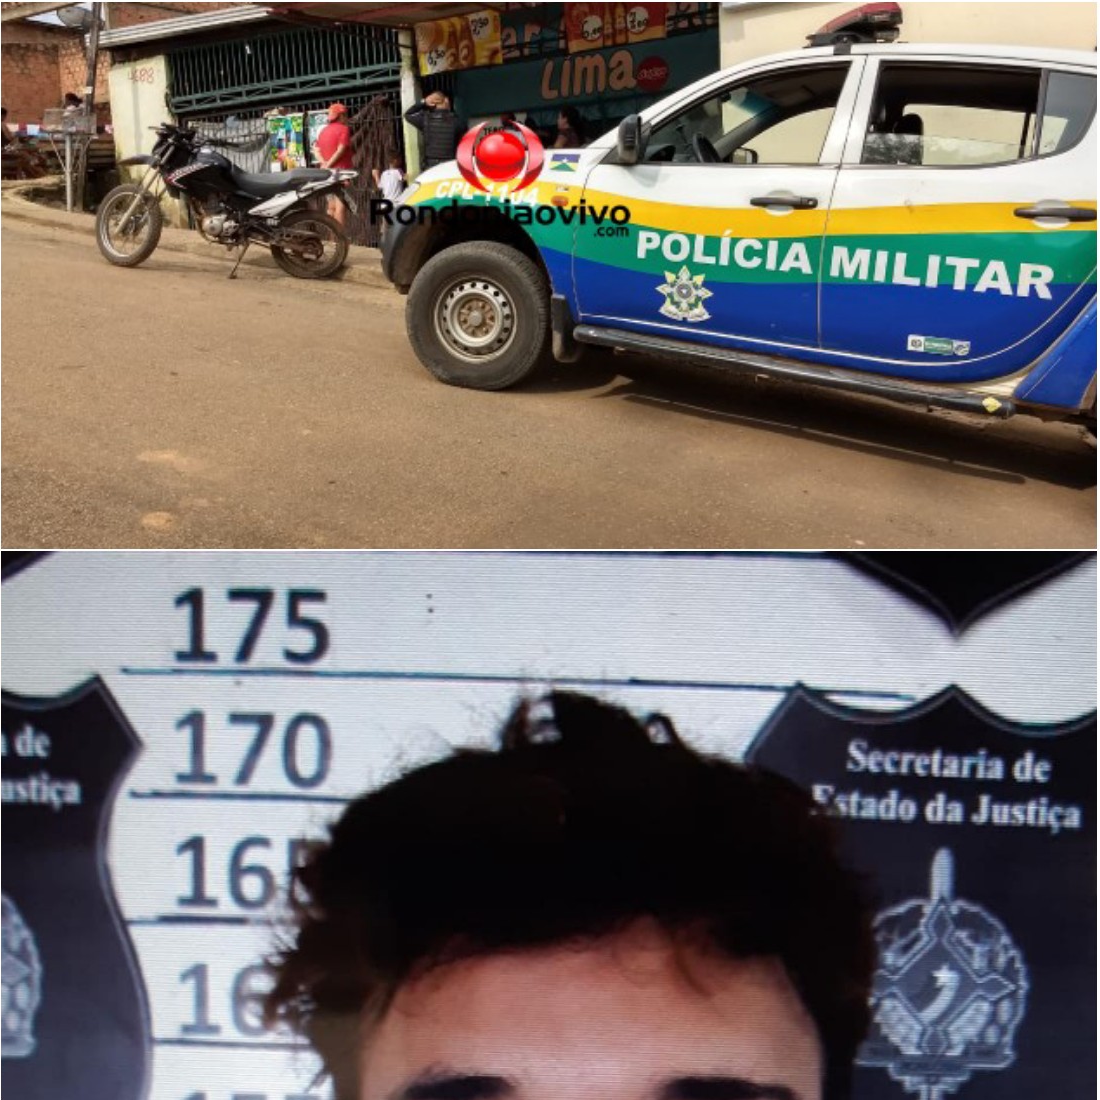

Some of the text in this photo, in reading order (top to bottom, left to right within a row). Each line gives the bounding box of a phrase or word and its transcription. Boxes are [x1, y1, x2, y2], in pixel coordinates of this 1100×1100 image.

[541, 49, 637, 99] Lima
[637, 229, 1054, 300] POLÍCIA MILITAR
[174, 587, 330, 663] 175
[15, 725, 50, 758] de
[174, 709, 331, 788] 170
[846, 738, 1052, 783] Secretaria de
[1, 774, 81, 807] ustiça
[924, 793, 964, 825] da
[971, 794, 1082, 835] Justiça
[179, 963, 280, 1036] 16
